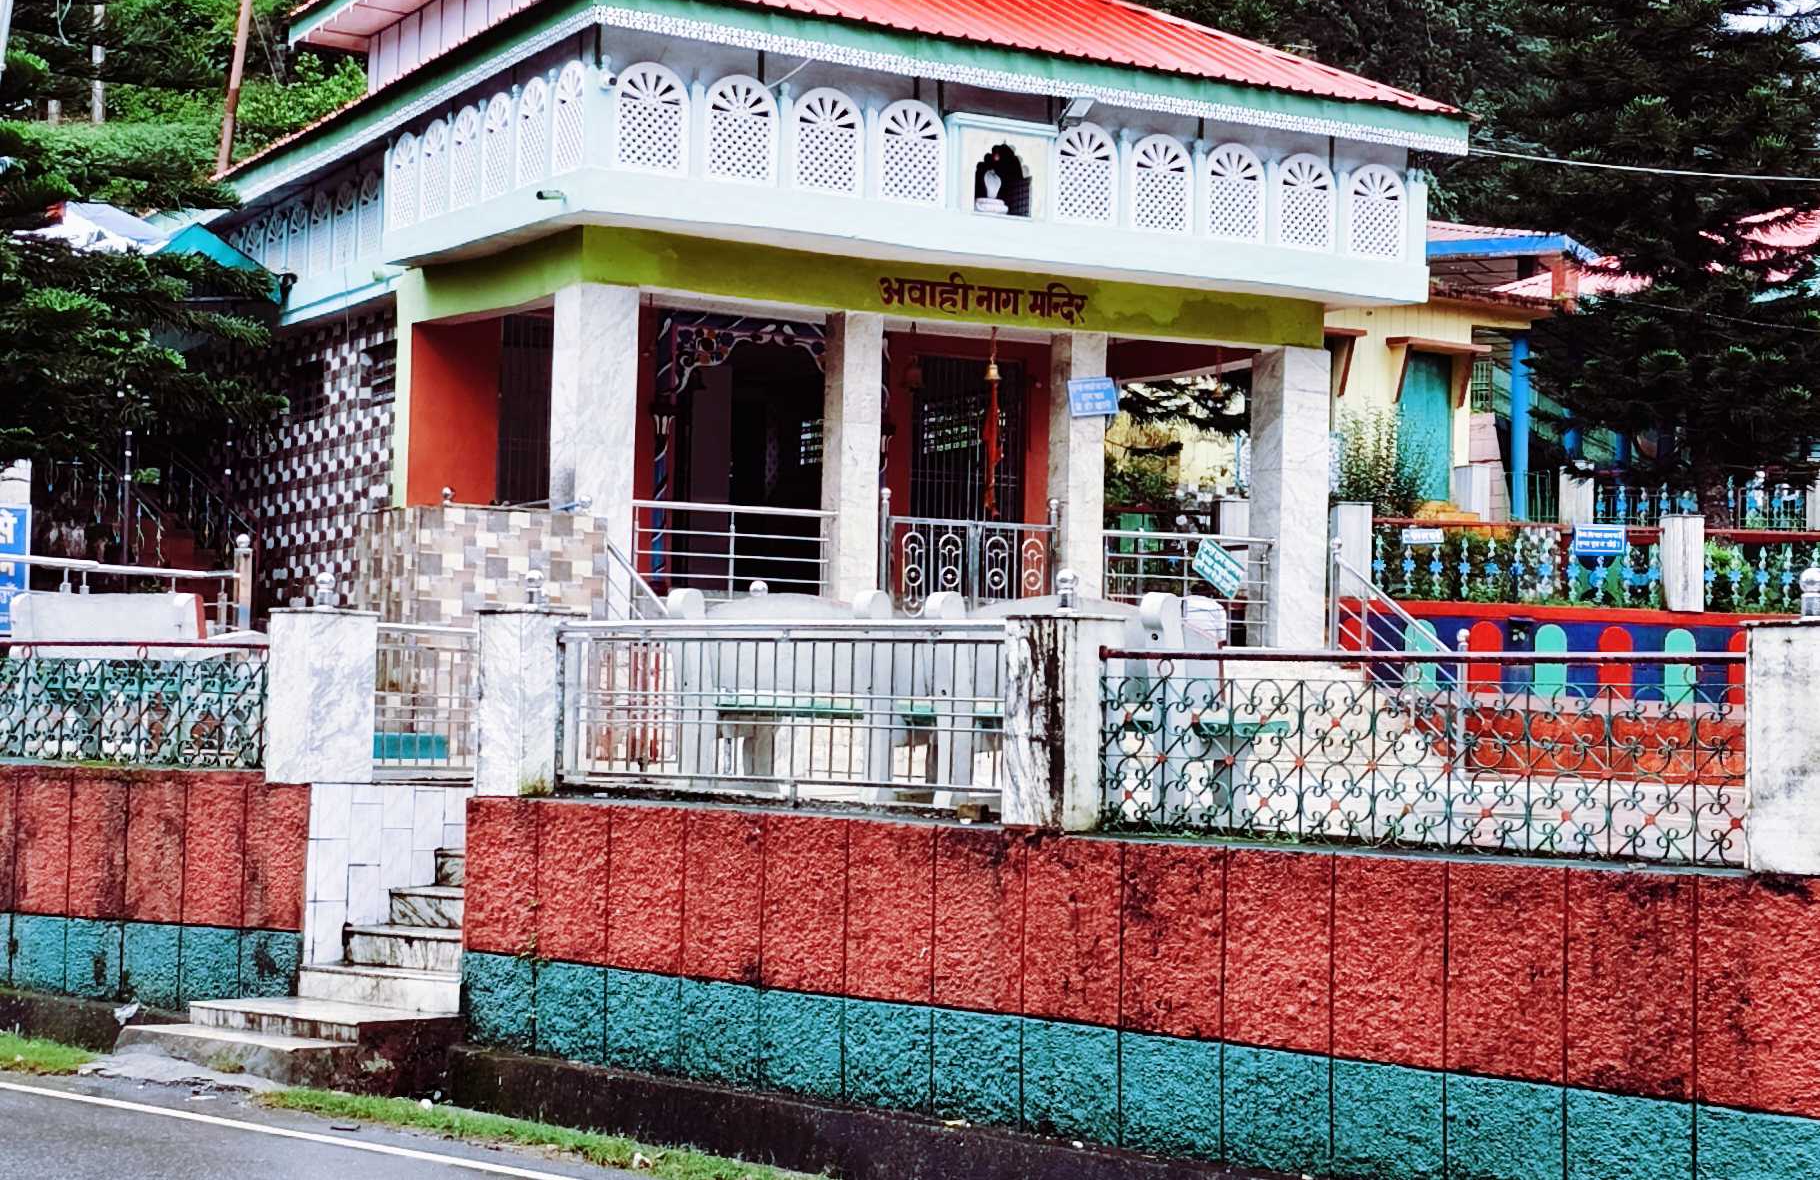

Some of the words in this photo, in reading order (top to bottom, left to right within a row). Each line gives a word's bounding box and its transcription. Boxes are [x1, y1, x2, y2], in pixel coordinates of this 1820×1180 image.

[880, 272, 974, 314] अवाही
[976, 286, 1024, 316] नाग
[1028, 283, 1088, 324] मन्दिर
